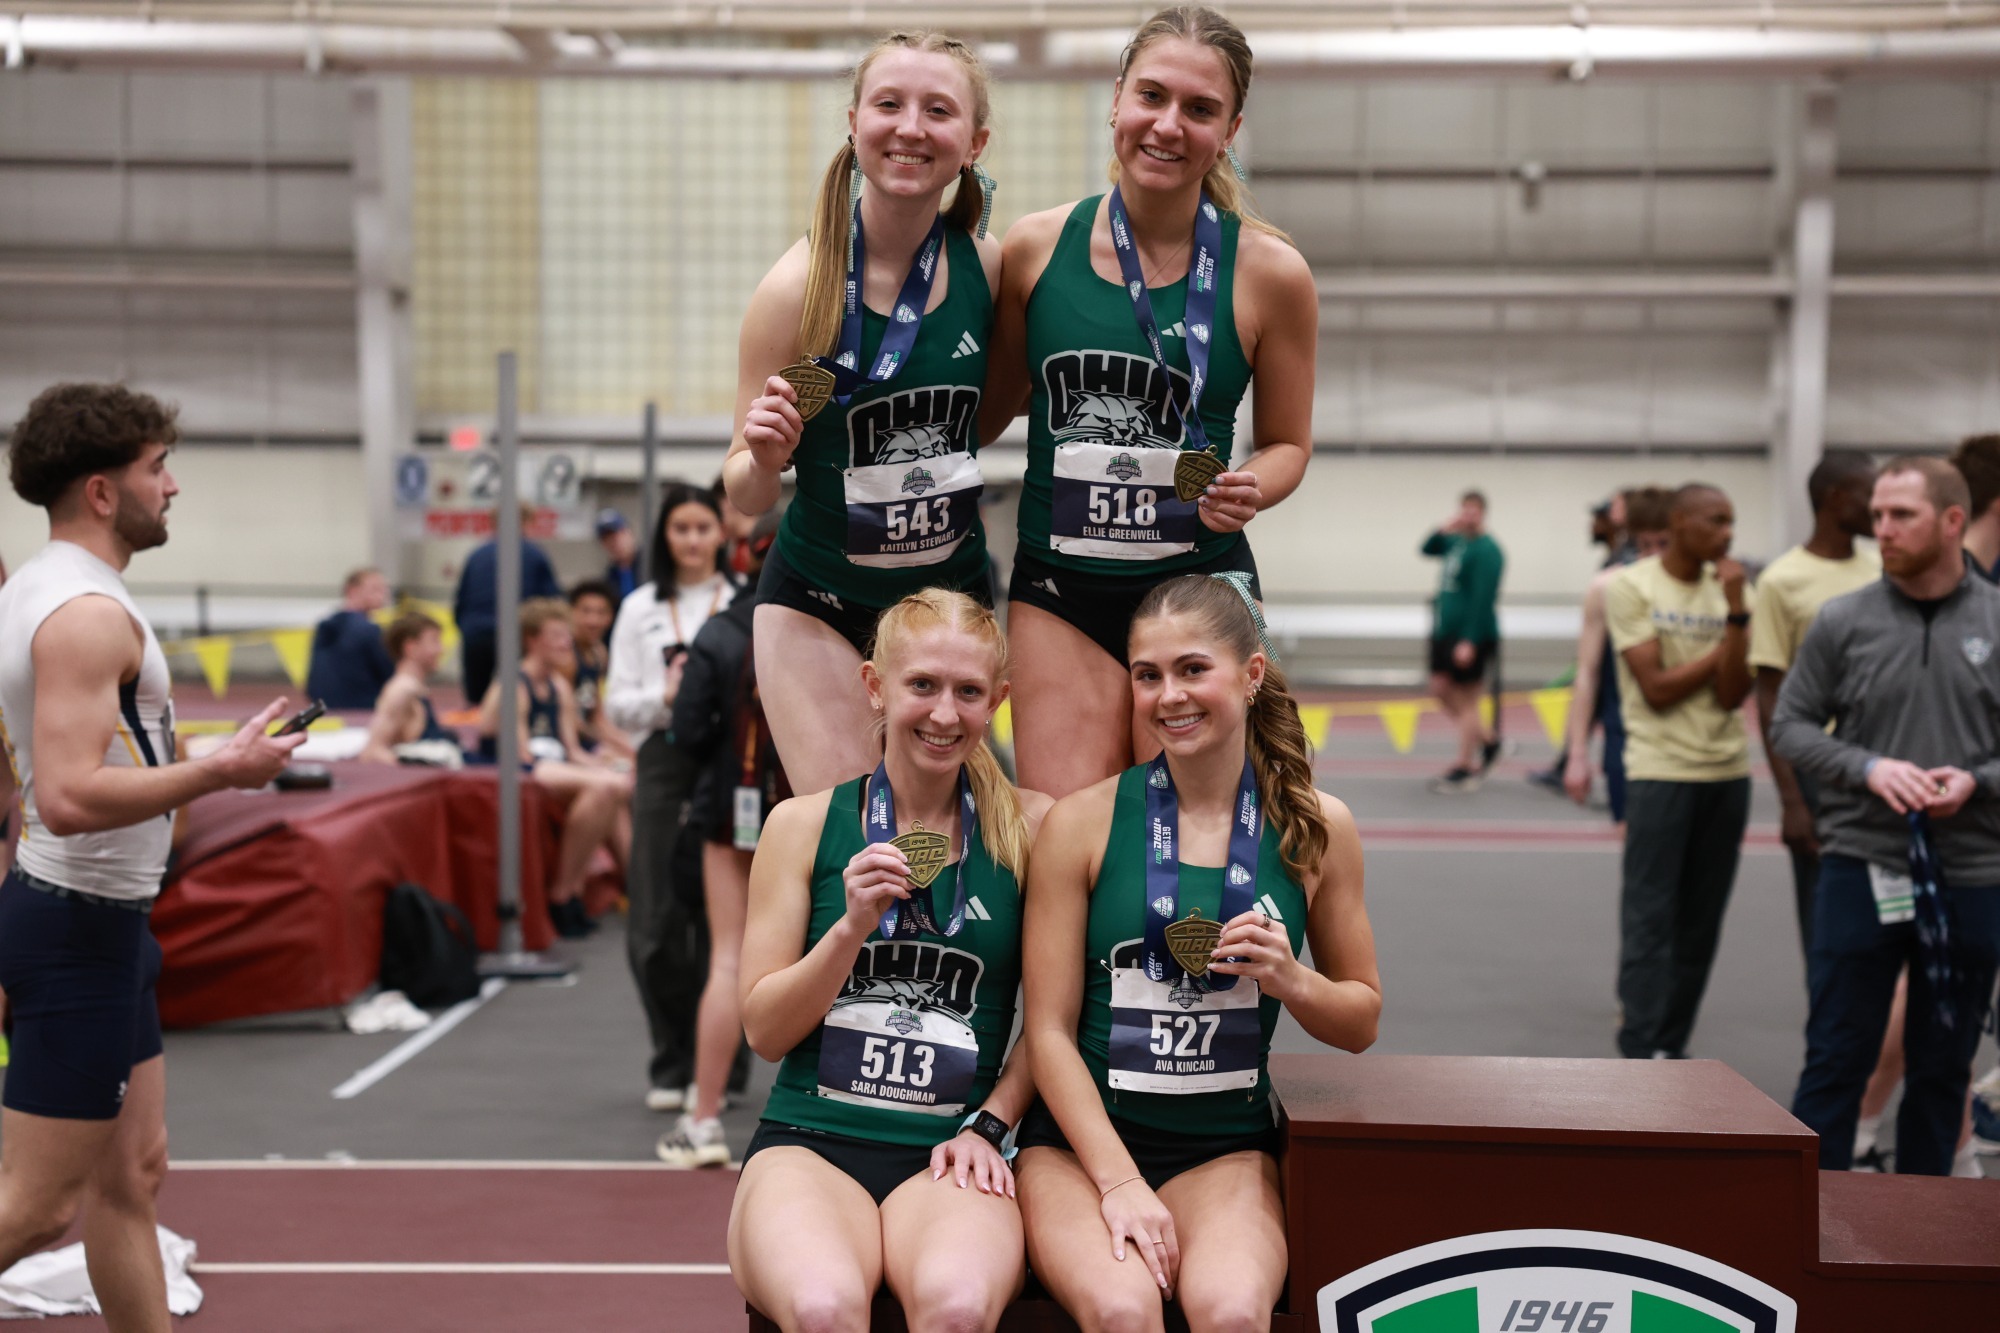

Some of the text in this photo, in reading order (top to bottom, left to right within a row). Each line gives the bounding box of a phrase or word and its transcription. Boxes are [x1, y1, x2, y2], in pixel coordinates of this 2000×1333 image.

[1203, 257, 1215, 290] GETSOME
[847, 280, 856, 315] GETSOME
[1042, 349, 1192, 446] OHIO
[847, 385, 980, 468] OHIO
[886, 496, 951, 540] 543
[1088, 485, 1157, 526] 518
[880, 529, 956, 552] KAITLYN STEWART
[1083, 526, 1162, 541] ELLIE GREENWELL
[1240, 790, 1251, 824] GETSOME
[1162, 826, 1171, 860] GETSOME
[1150, 1014, 1221, 1057] 527
[860, 1036, 935, 1087] 513
[1154, 1060, 1215, 1072] AVA KINCAID
[851, 1080, 936, 1103] SARA DOUGHMAN
[1500, 1300, 1614, 1333] 1946
